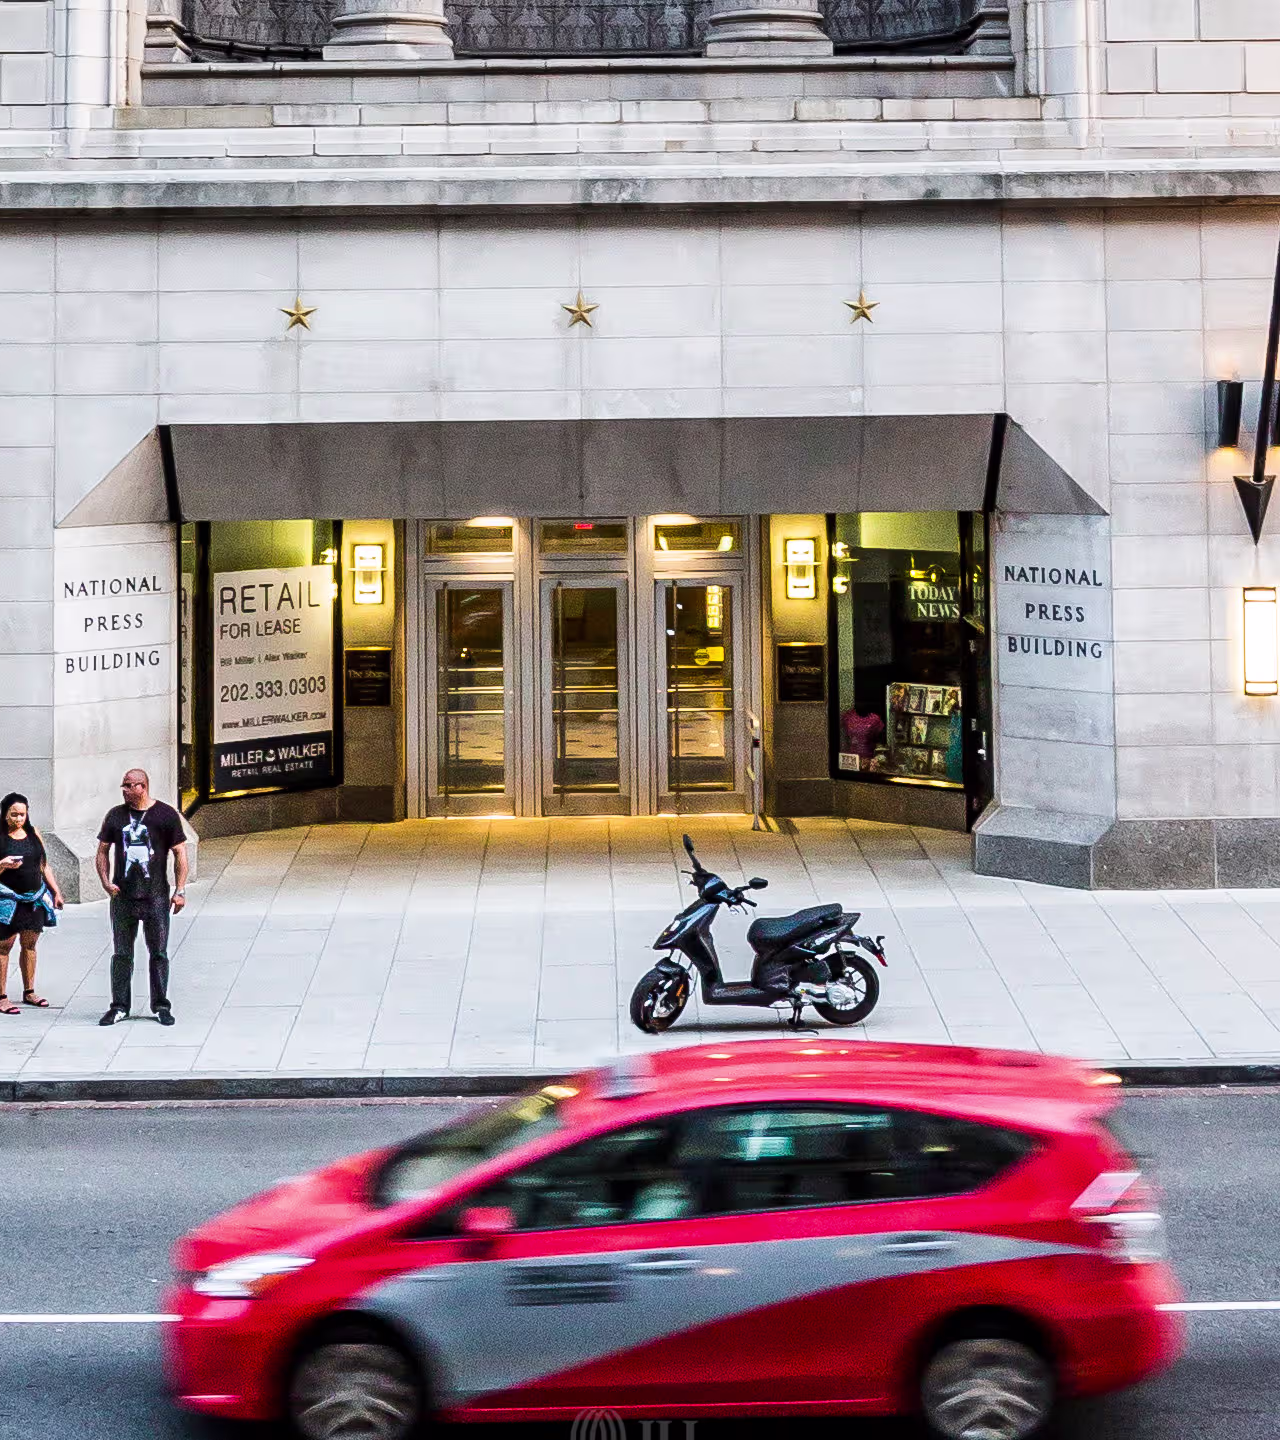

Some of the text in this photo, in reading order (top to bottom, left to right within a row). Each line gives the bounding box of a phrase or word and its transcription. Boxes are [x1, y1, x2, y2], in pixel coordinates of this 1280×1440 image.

[64, 575, 162, 598] NATIONAL
[1004, 565, 1103, 587] NATIONAL
[219, 580, 321, 616] RETAIL
[916, 602, 960, 619] NEWS
[1025, 602, 1085, 623] PRESS
[84, 612, 143, 633] PRESS
[220, 617, 302, 640] FOR LEASE
[1008, 635, 1103, 659] BUILDING
[65, 650, 160, 674] BUILDING
[220, 675, 326, 703] 202.333.0303
[220, 742, 326, 768] MILLER WALKER
